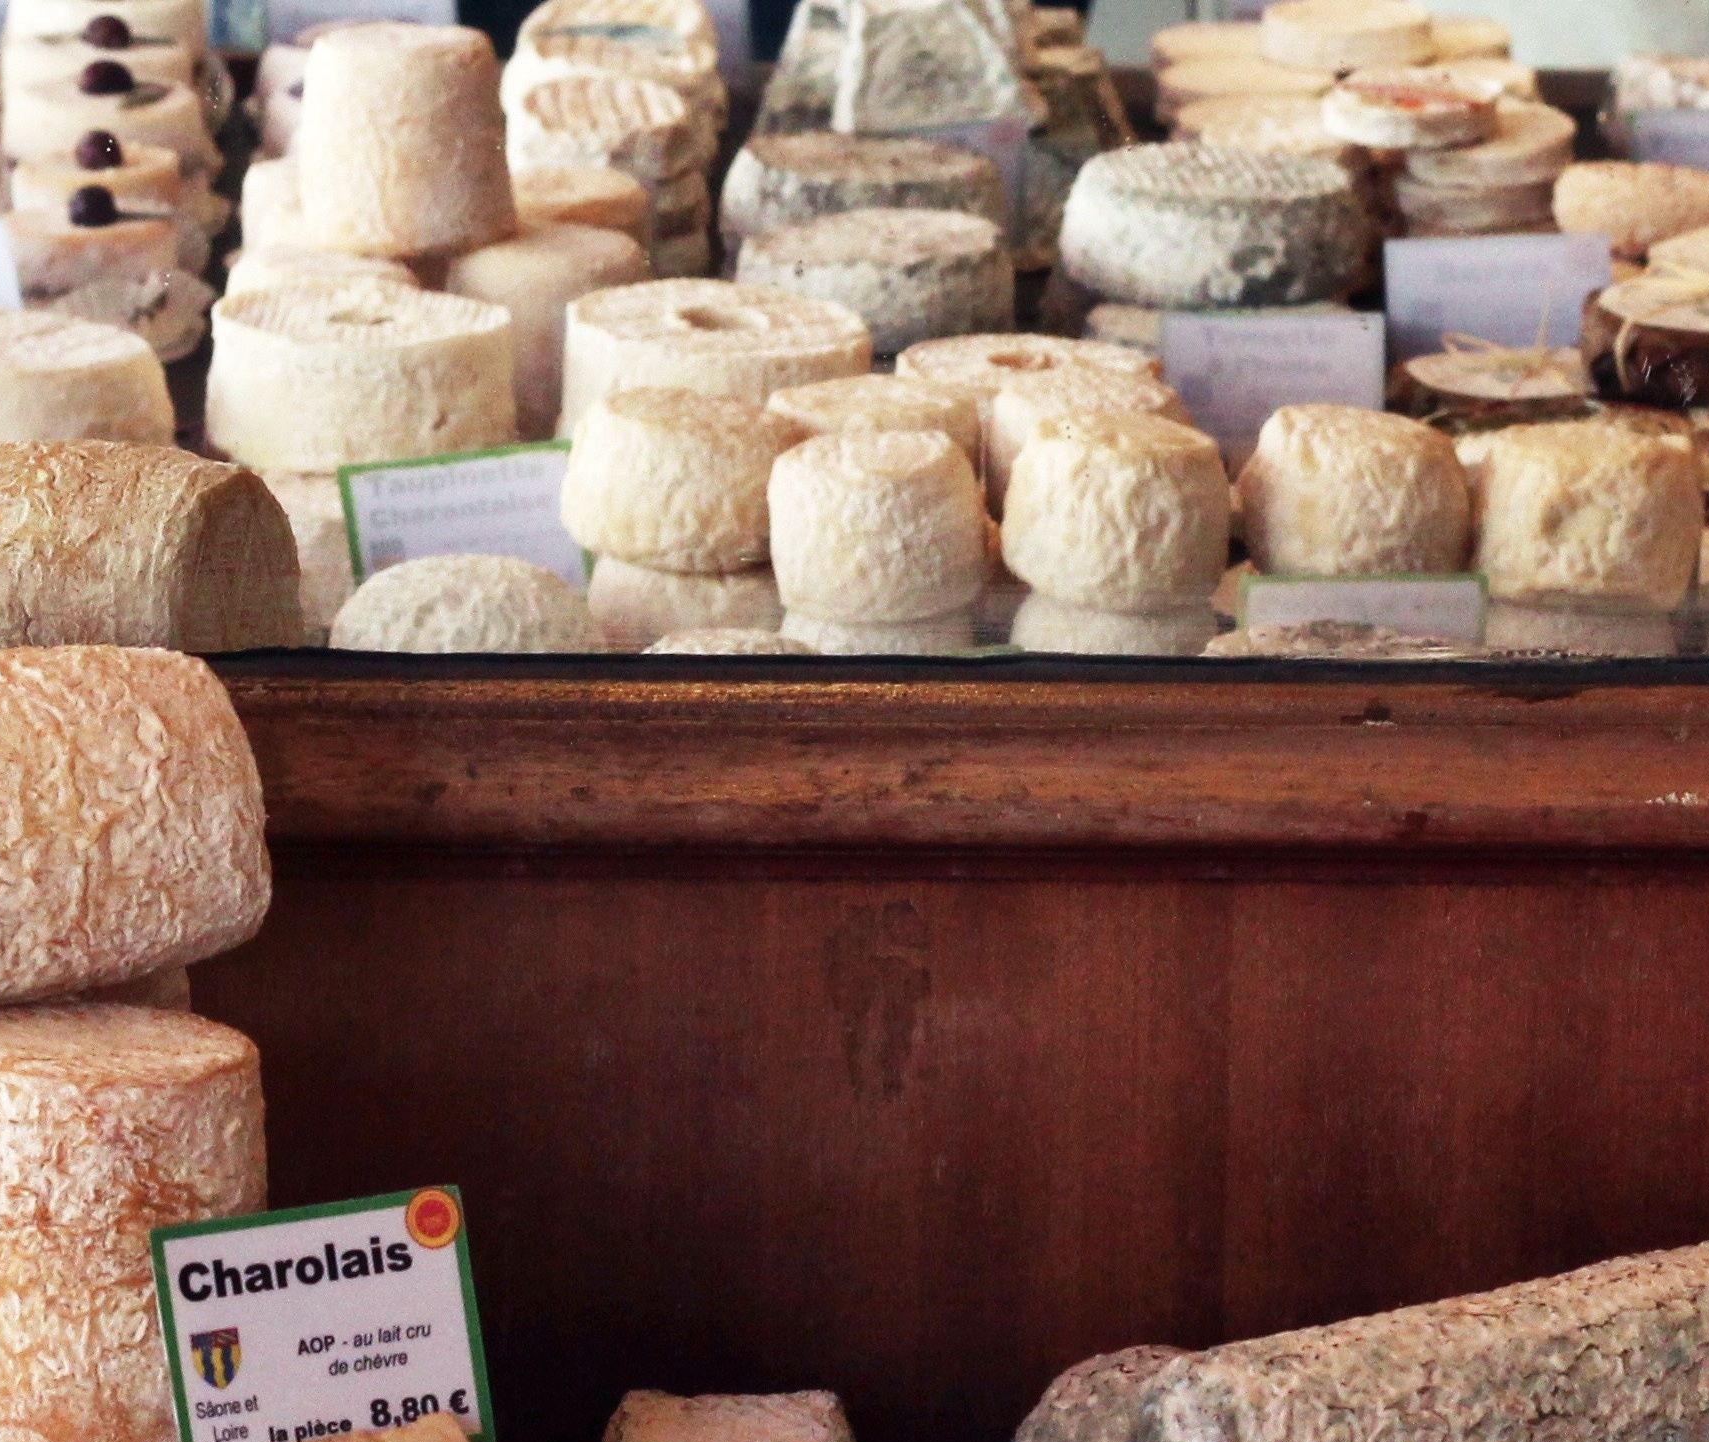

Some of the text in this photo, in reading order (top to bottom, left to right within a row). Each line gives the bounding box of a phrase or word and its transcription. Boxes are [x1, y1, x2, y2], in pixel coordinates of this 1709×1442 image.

[178, 1236, 414, 1303] Charolais
[296, 1334, 336, 1357] AOP
[353, 1332, 374, 1349] au
[377, 1326, 402, 1346] lait
[405, 1322, 433, 1341] cru
[328, 1349, 409, 1377] de chèvre
[244, 1393, 260, 1411] et
[369, 1387, 471, 1429] 8,80 €
